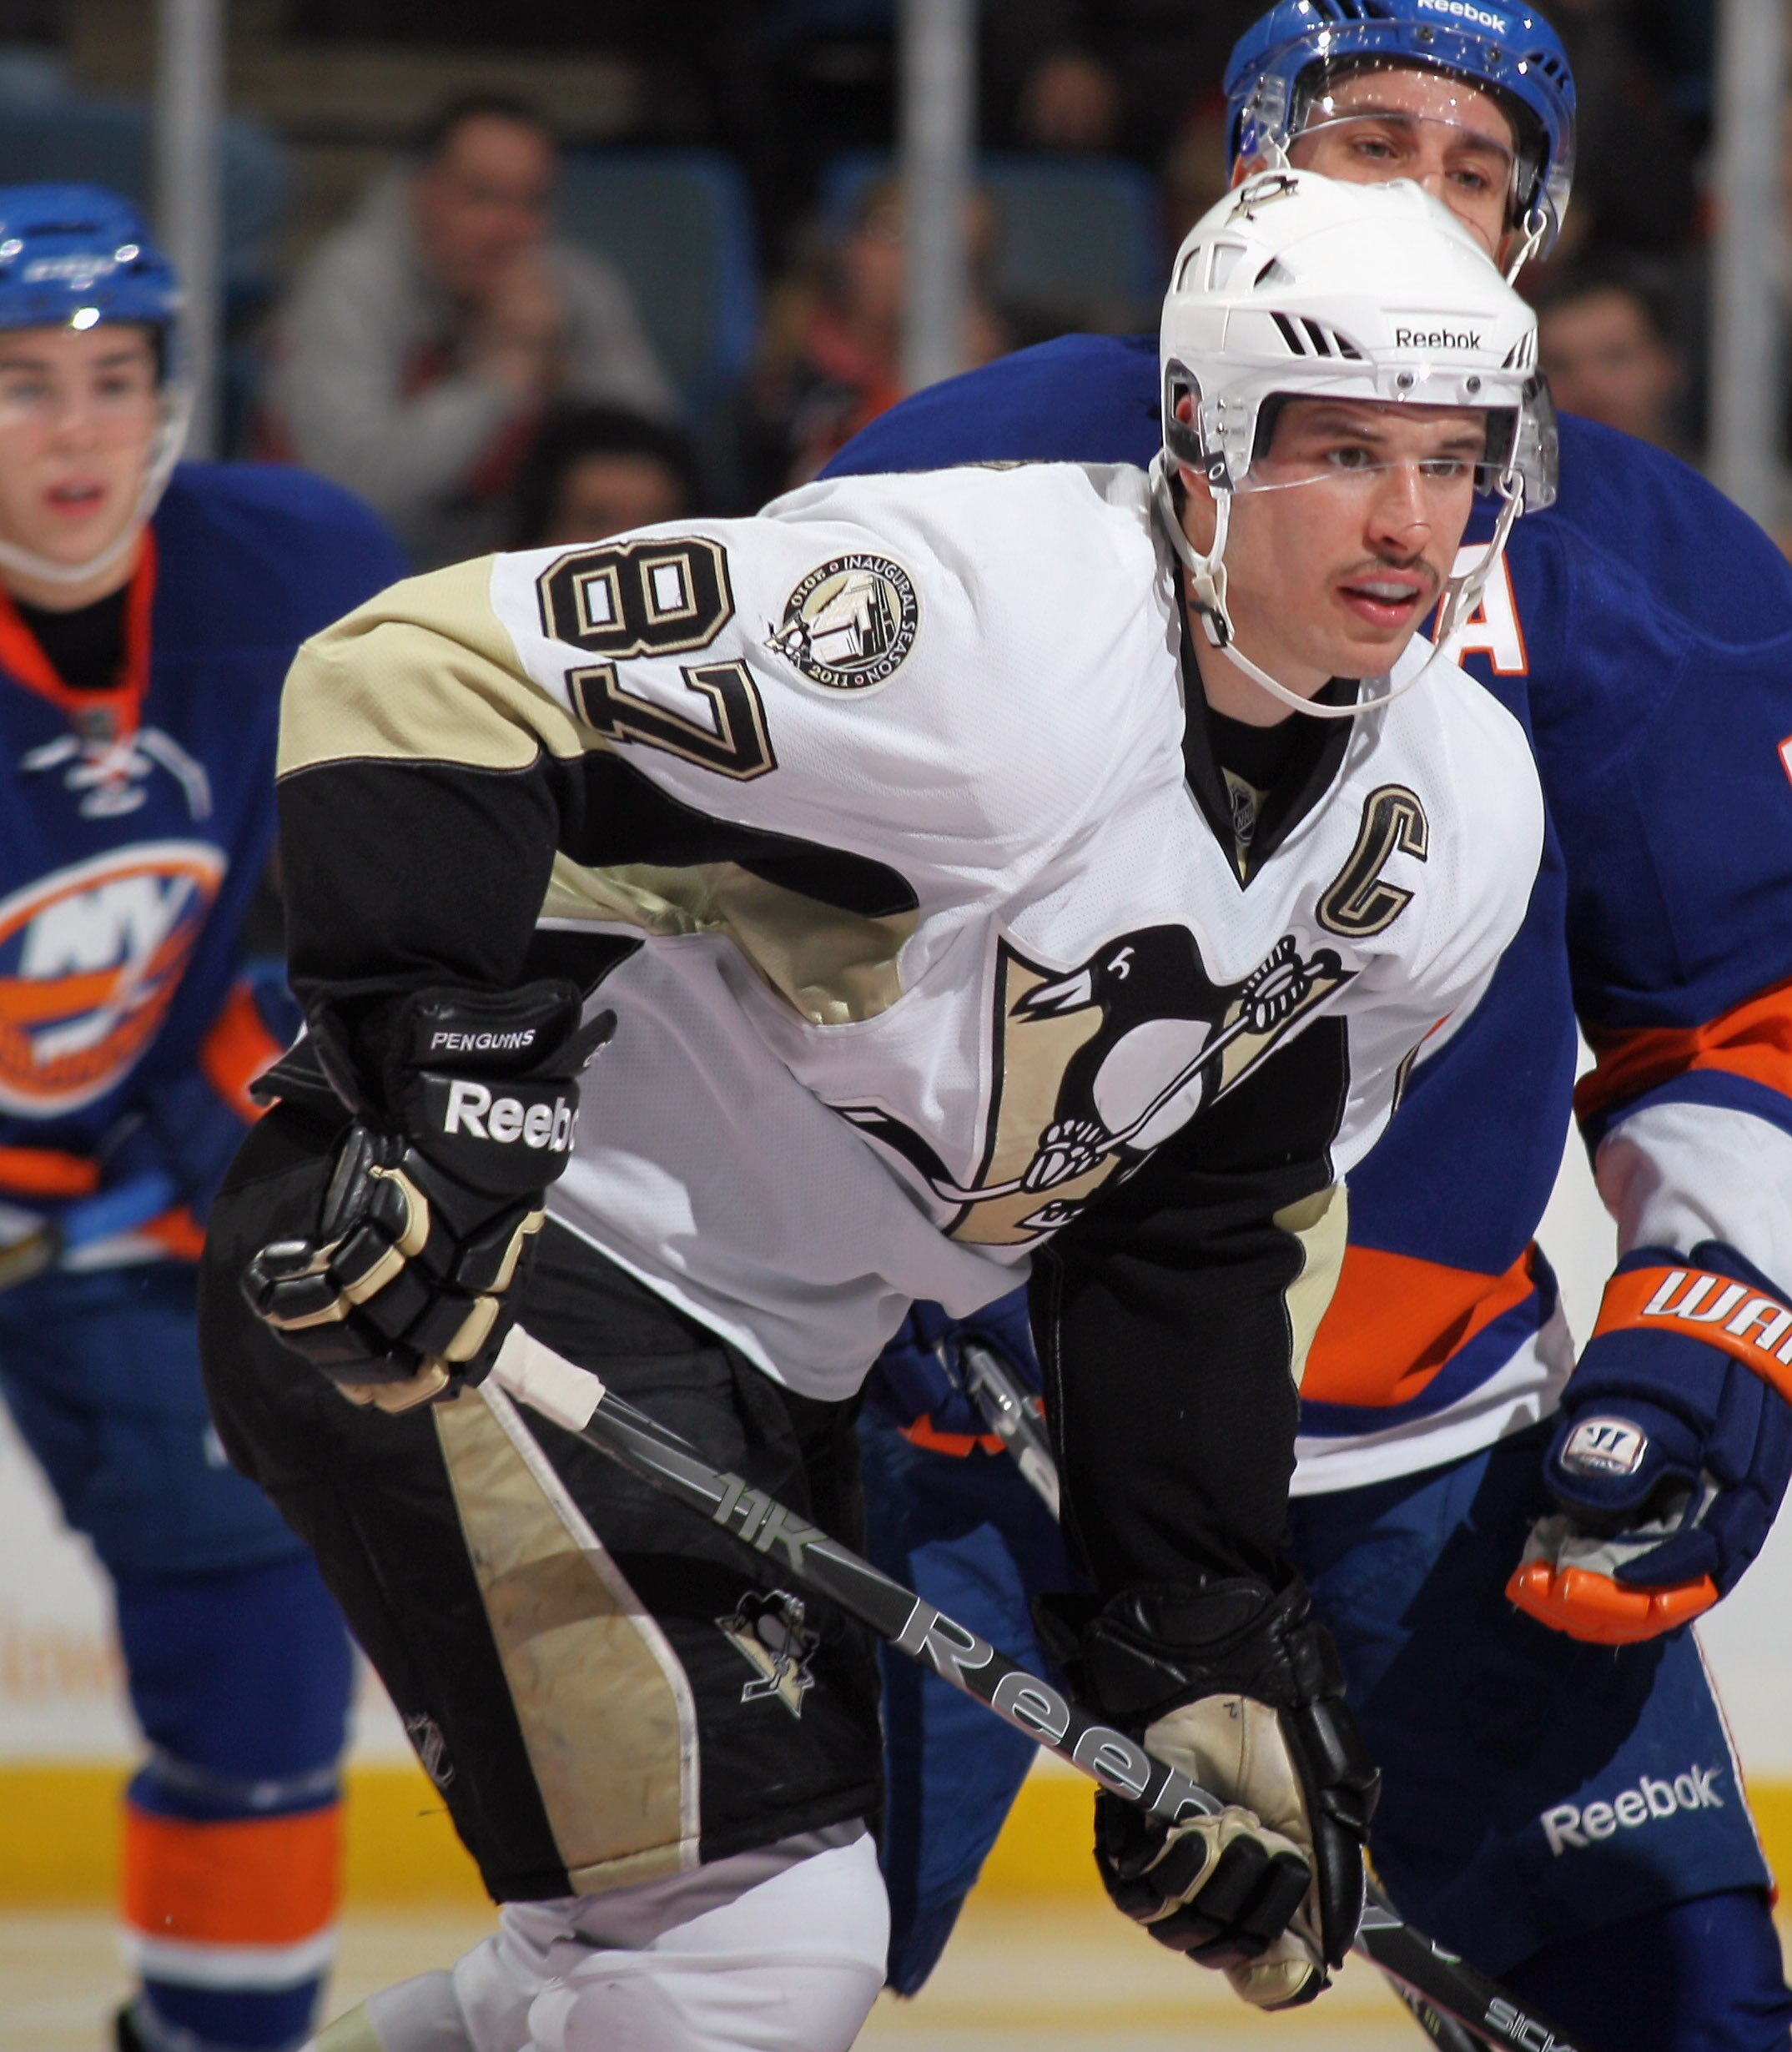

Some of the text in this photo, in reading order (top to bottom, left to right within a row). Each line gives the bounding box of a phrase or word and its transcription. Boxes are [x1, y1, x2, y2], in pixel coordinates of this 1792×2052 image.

[1396, 328, 1481, 350] Reebok
[536, 535, 778, 782] 87
[843, 556, 916, 684] INAUGURAL SEASON
[1431, 542, 1529, 676] A
[808, 665, 849, 687] 2011
[1316, 784, 1429, 938] C
[430, 1029, 536, 1052] PENGUINS
[1540, 1763, 1725, 1858] Reebok
